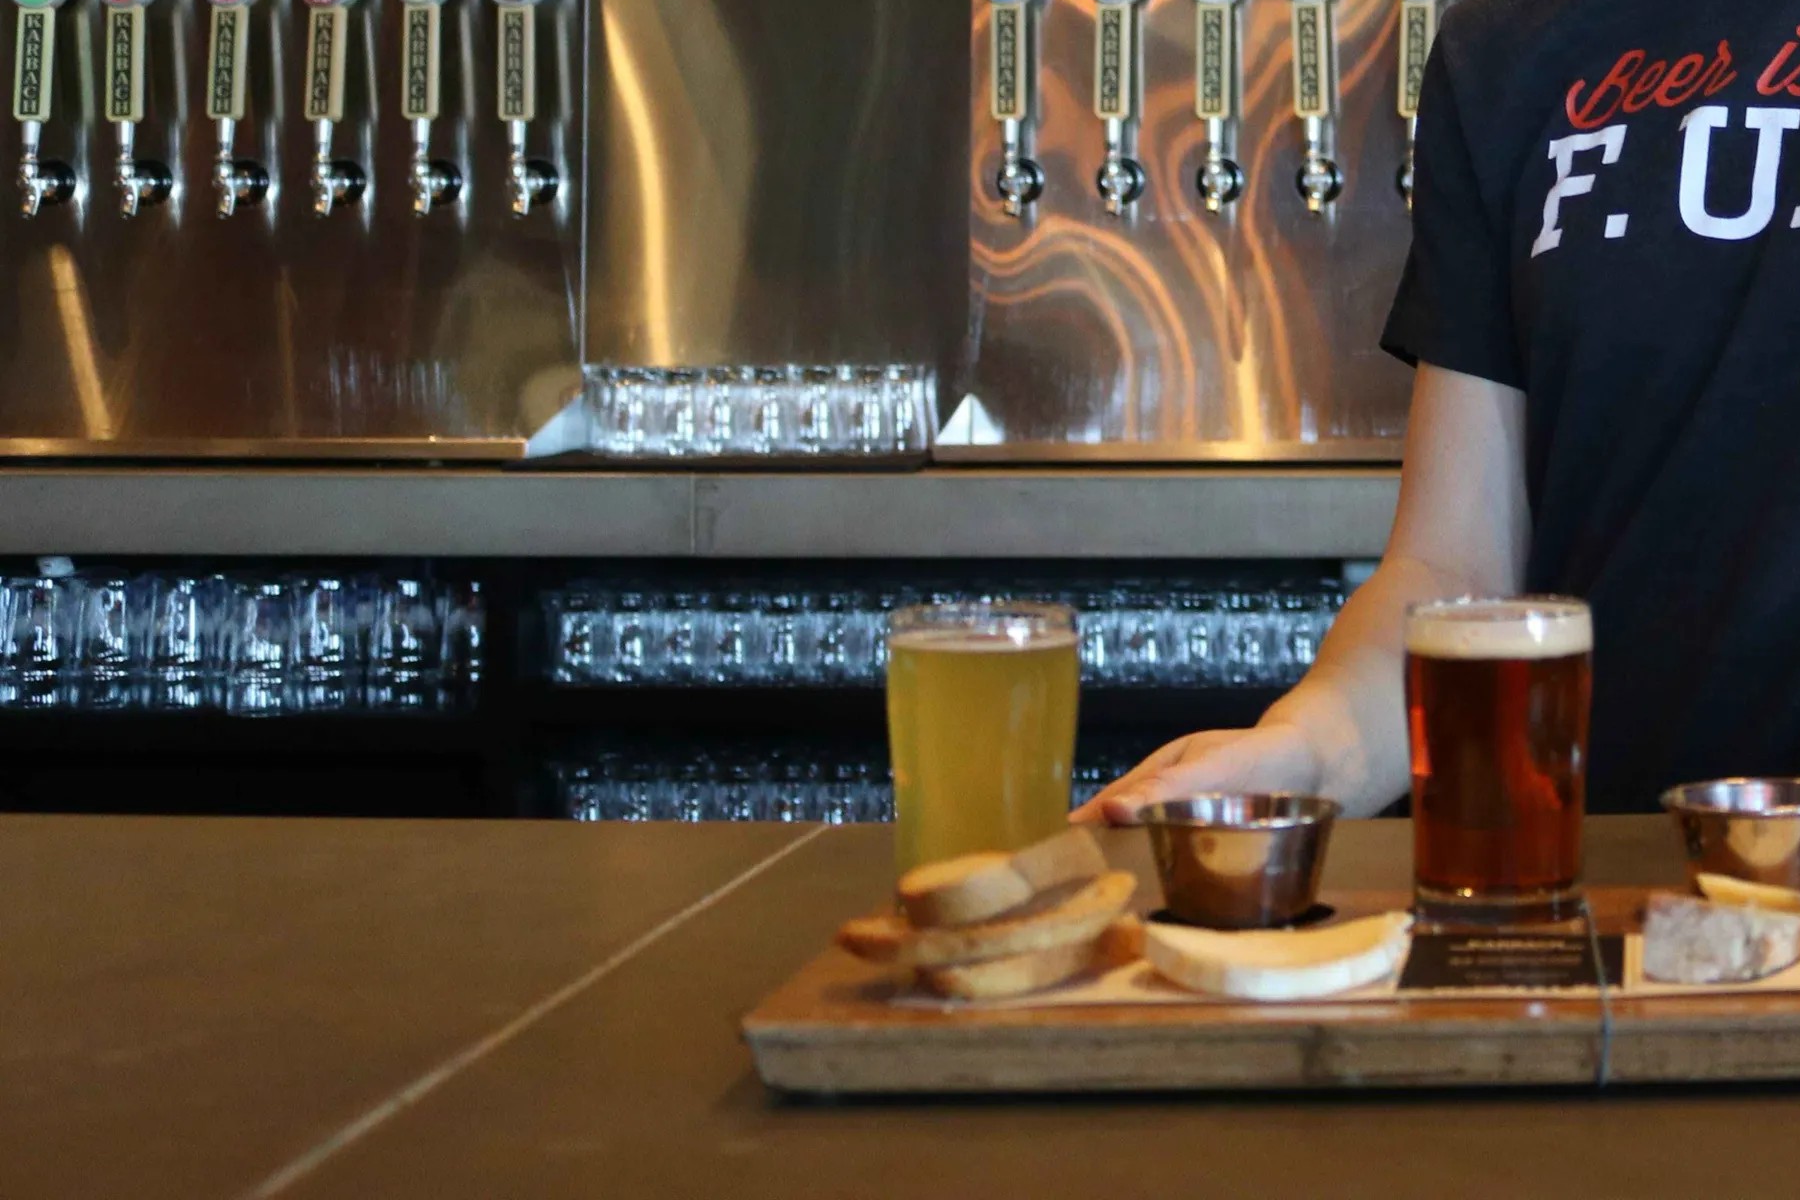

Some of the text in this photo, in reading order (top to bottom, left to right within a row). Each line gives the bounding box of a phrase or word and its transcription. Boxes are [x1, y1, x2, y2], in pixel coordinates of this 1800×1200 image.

[22, 13, 42, 114] KARBACH
[112, 13, 131, 115] KARBACH
[213, 11, 236, 114] KARBACH
[312, 13, 333, 114] KARBACH
[410, 10, 428, 113] KARBACH
[506, 13, 523, 114] KARBACH
[1566, 39, 1739, 129] Beer
